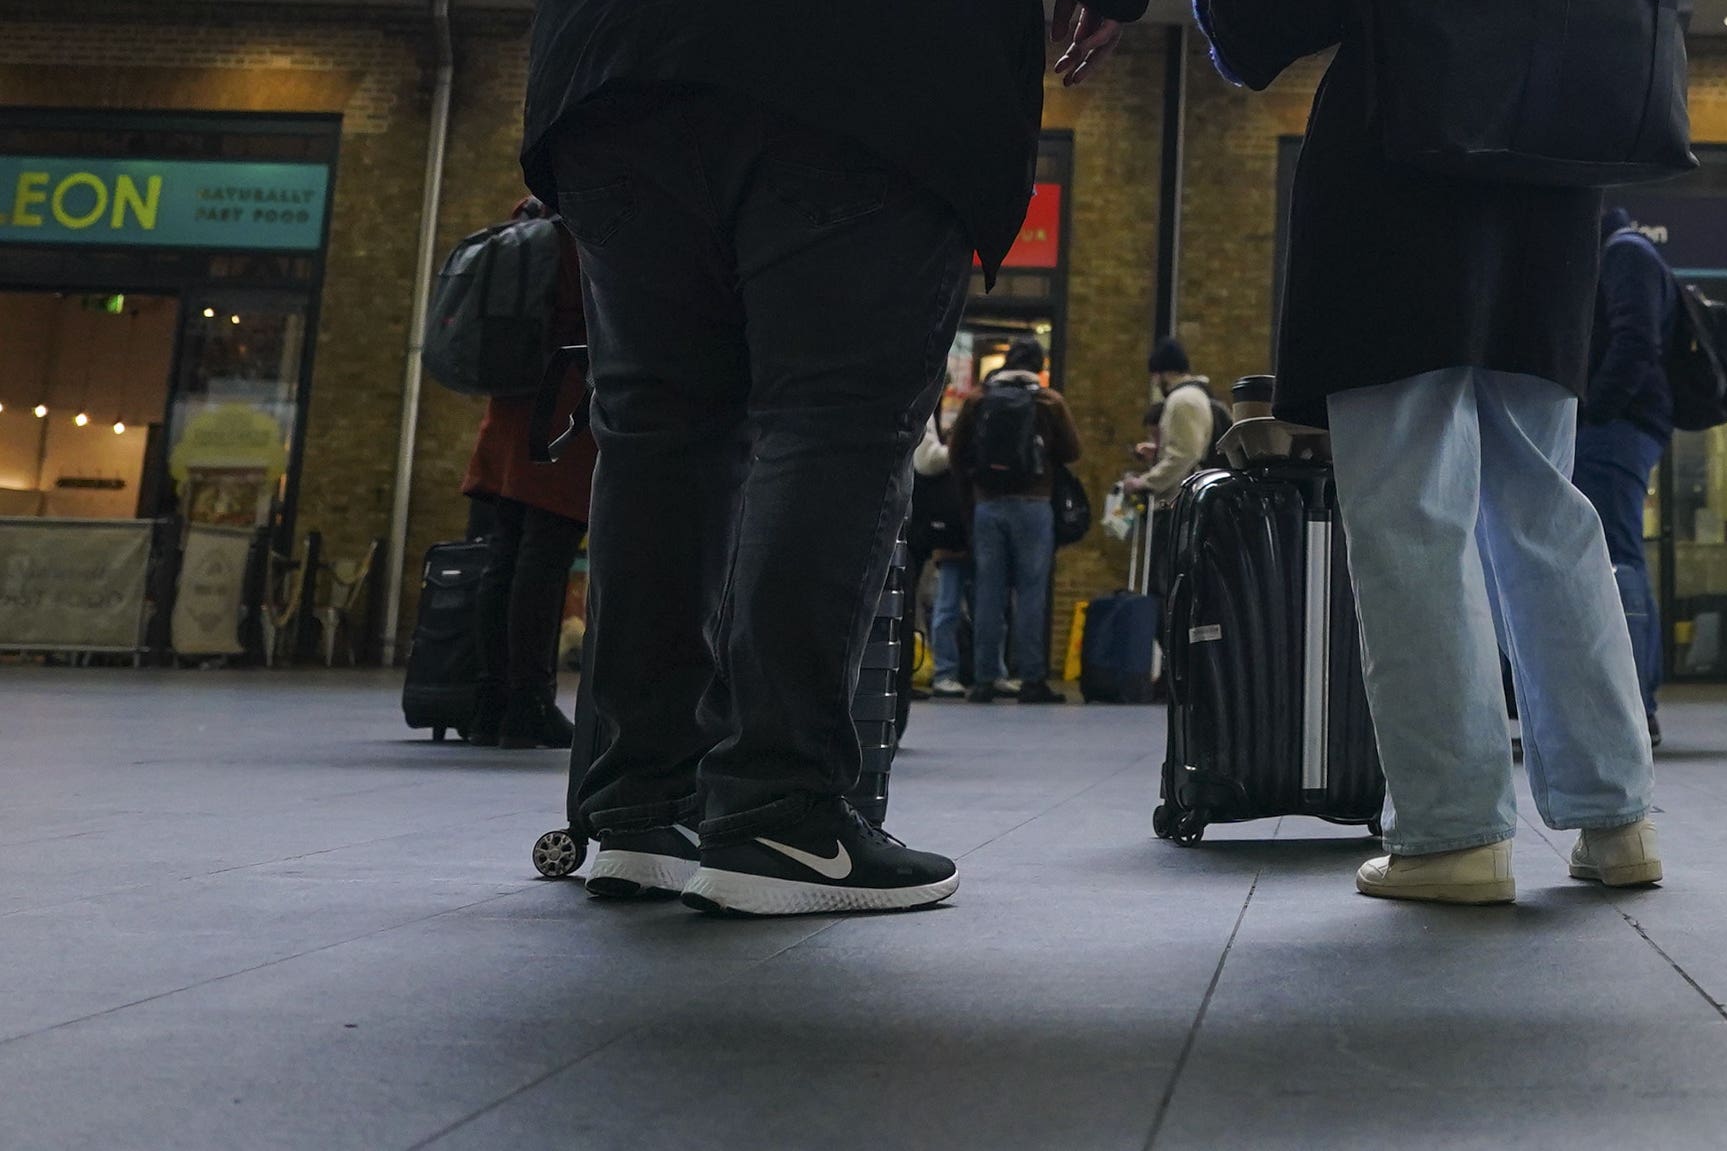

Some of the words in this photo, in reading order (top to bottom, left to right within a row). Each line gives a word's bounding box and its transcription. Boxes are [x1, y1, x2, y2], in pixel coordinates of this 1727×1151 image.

[0, 171, 163, 231] EON
[196, 187, 316, 203] NATURALLY
[253, 209, 310, 223] FOOD
